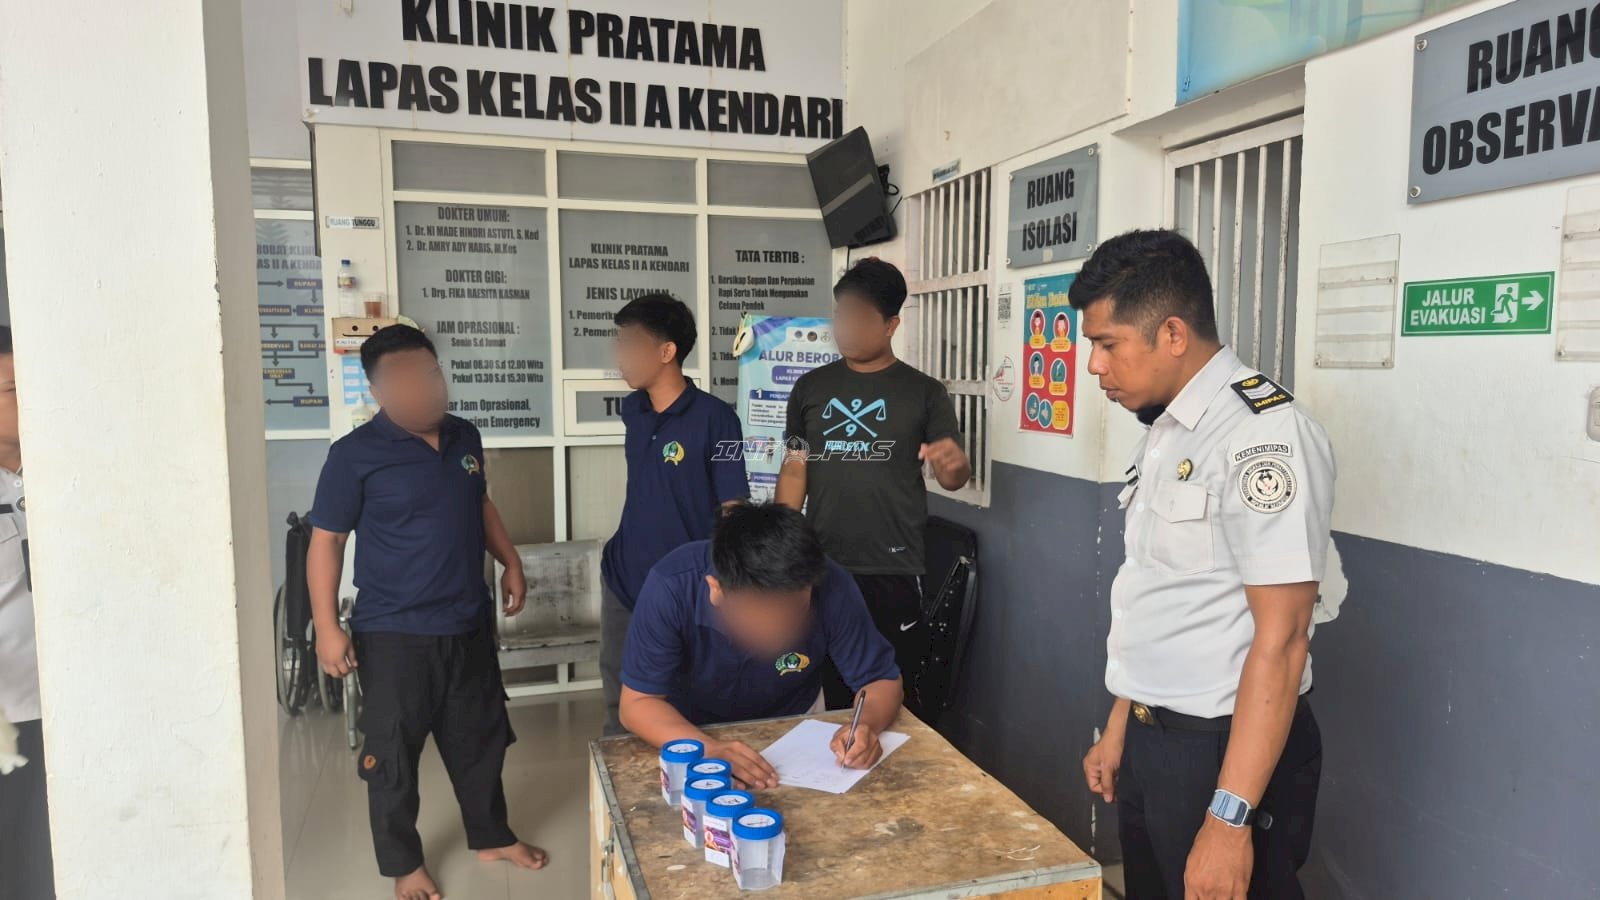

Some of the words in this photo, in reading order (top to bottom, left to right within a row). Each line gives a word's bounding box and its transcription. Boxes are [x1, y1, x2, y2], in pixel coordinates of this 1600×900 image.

[402, 0, 557, 53] KLINIK
[569, 9, 765, 71] PRATAMA
[308, 57, 458, 113] LAPAS
[467, 69, 601, 124] KELAS
[609, 81, 636, 126] II
[644, 84, 672, 128] A
[679, 87, 843, 139] KENDARI
[1027, 168, 1075, 210] RUANG
[437, 206, 475, 221] DOKTER
[477, 208, 510, 222] UMUM:
[1022, 211, 1077, 251] ISOLASI
[591, 243, 623, 255] KLINIK
[625, 244, 669, 257] PRATAMA
[736, 249, 761, 263] TATA
[762, 250, 800, 264] TERTIB
[569, 257, 599, 269] LAPAS
[601, 258, 631, 270] KELAS
[632, 259, 639, 271] II
[641, 260, 648, 271] A
[650, 261, 690, 273] KENDARI
[445, 269, 482, 284] DOKTER
[484, 271, 508, 284] GIGI:
[586, 286, 618, 300] JENIS
[1422, 287, 1475, 307] JALUR
[1410, 307, 1486, 326] EVAKUASI
[436, 321, 456, 334] JAM
[457, 321, 515, 335] OPRASIONAL
[758, 350, 794, 362] ALUR
[756, 388, 762, 399] 1
[460, 399, 478, 411] Jam
[851, 399, 862, 412] 9
[491, 415, 541, 429] Emergency
[1234, 443, 1290, 461] KEMENIMIPAS
